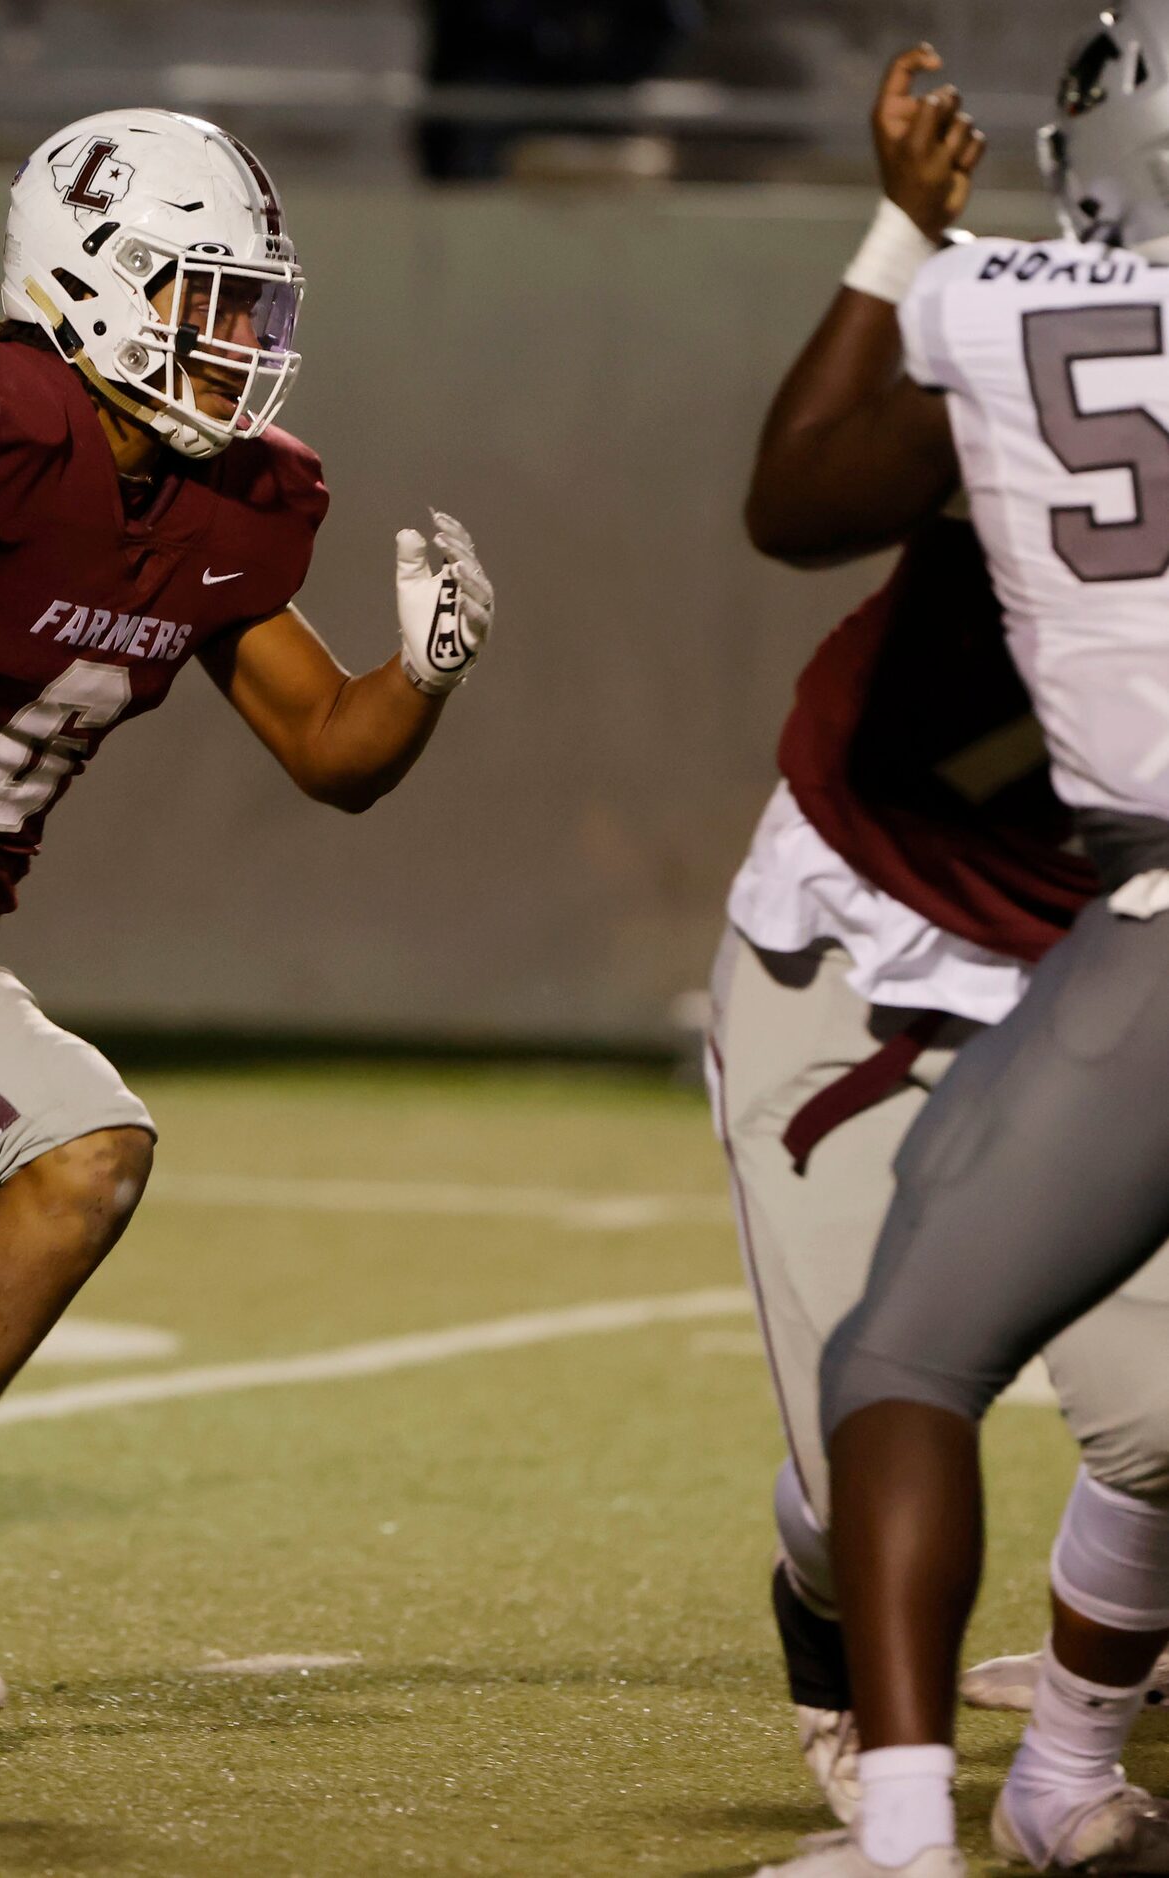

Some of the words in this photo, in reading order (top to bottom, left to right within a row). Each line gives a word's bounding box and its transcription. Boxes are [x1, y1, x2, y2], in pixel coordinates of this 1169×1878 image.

[62, 141, 119, 214] L
[1021, 303, 1169, 583] 5
[30, 600, 193, 660] FARMERS
